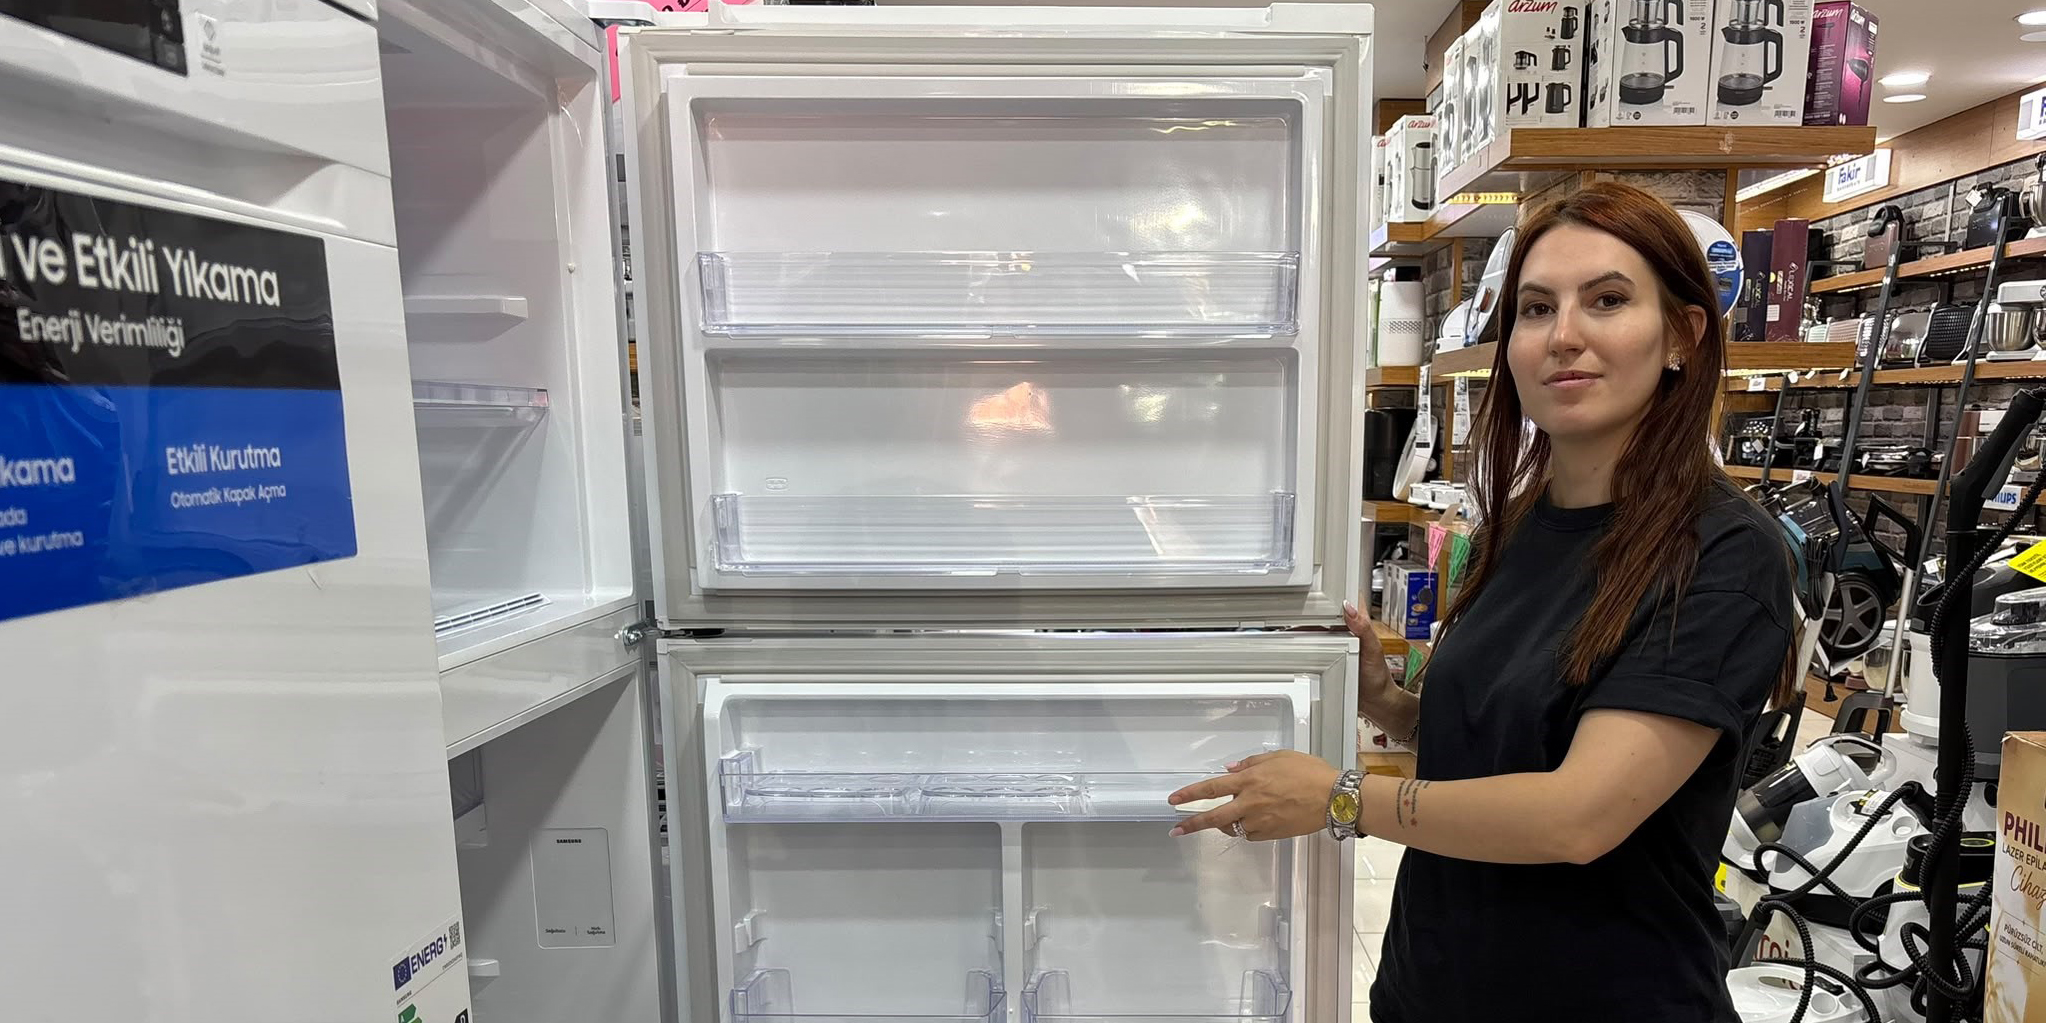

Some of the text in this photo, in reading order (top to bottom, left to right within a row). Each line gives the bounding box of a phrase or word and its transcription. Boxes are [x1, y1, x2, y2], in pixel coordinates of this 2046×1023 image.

[1508, 0, 1558, 14] arzum
[10, 233, 68, 285] ve
[72, 231, 160, 294] Etkili
[161, 245, 280, 307] Yıkama
[16, 306, 185, 358] Enerji Verimliliği
[165, 443, 281, 475] Etkili Kurutma
[170, 484, 287, 509] Otomatik Kapak Açma
[18, 530, 84, 554] kurutma
[2003, 810, 2046, 855] PHIL
[2002, 842, 2024, 862] LAZER
[2003, 923, 2032, 947] PÜRÜZSÜZ
[410, 935, 445, 975] ENERG
